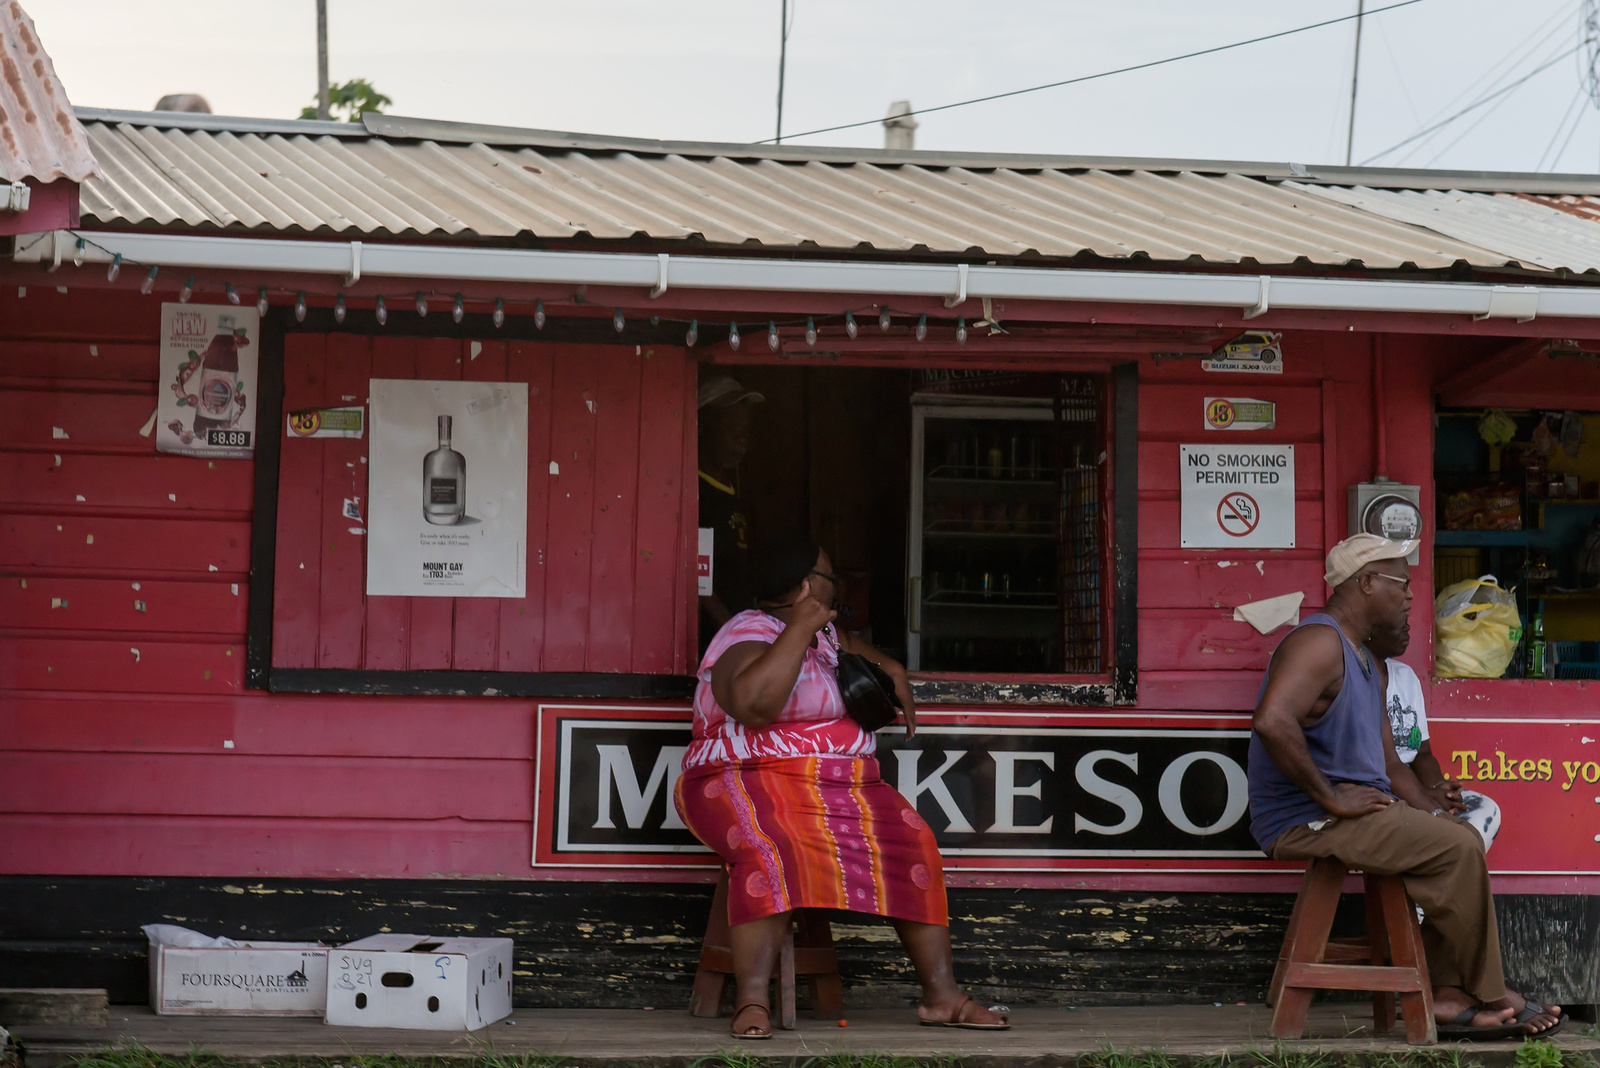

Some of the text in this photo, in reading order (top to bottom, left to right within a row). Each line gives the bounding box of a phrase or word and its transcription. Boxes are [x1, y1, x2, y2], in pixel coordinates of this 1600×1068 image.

[172, 317, 206, 336] NEW
[1213, 404, 1229, 423] 18
[212, 431, 245, 446] $8.88
[1188, 453, 1287, 467] NO SMOKING
[1196, 471, 1280, 484] PERMITTED
[423, 562, 464, 571] MOUNT GAY
[429, 570, 444, 579] 1703
[591, 744, 1250, 836] MKESO
[181, 972, 285, 989] FOURSQUARE
